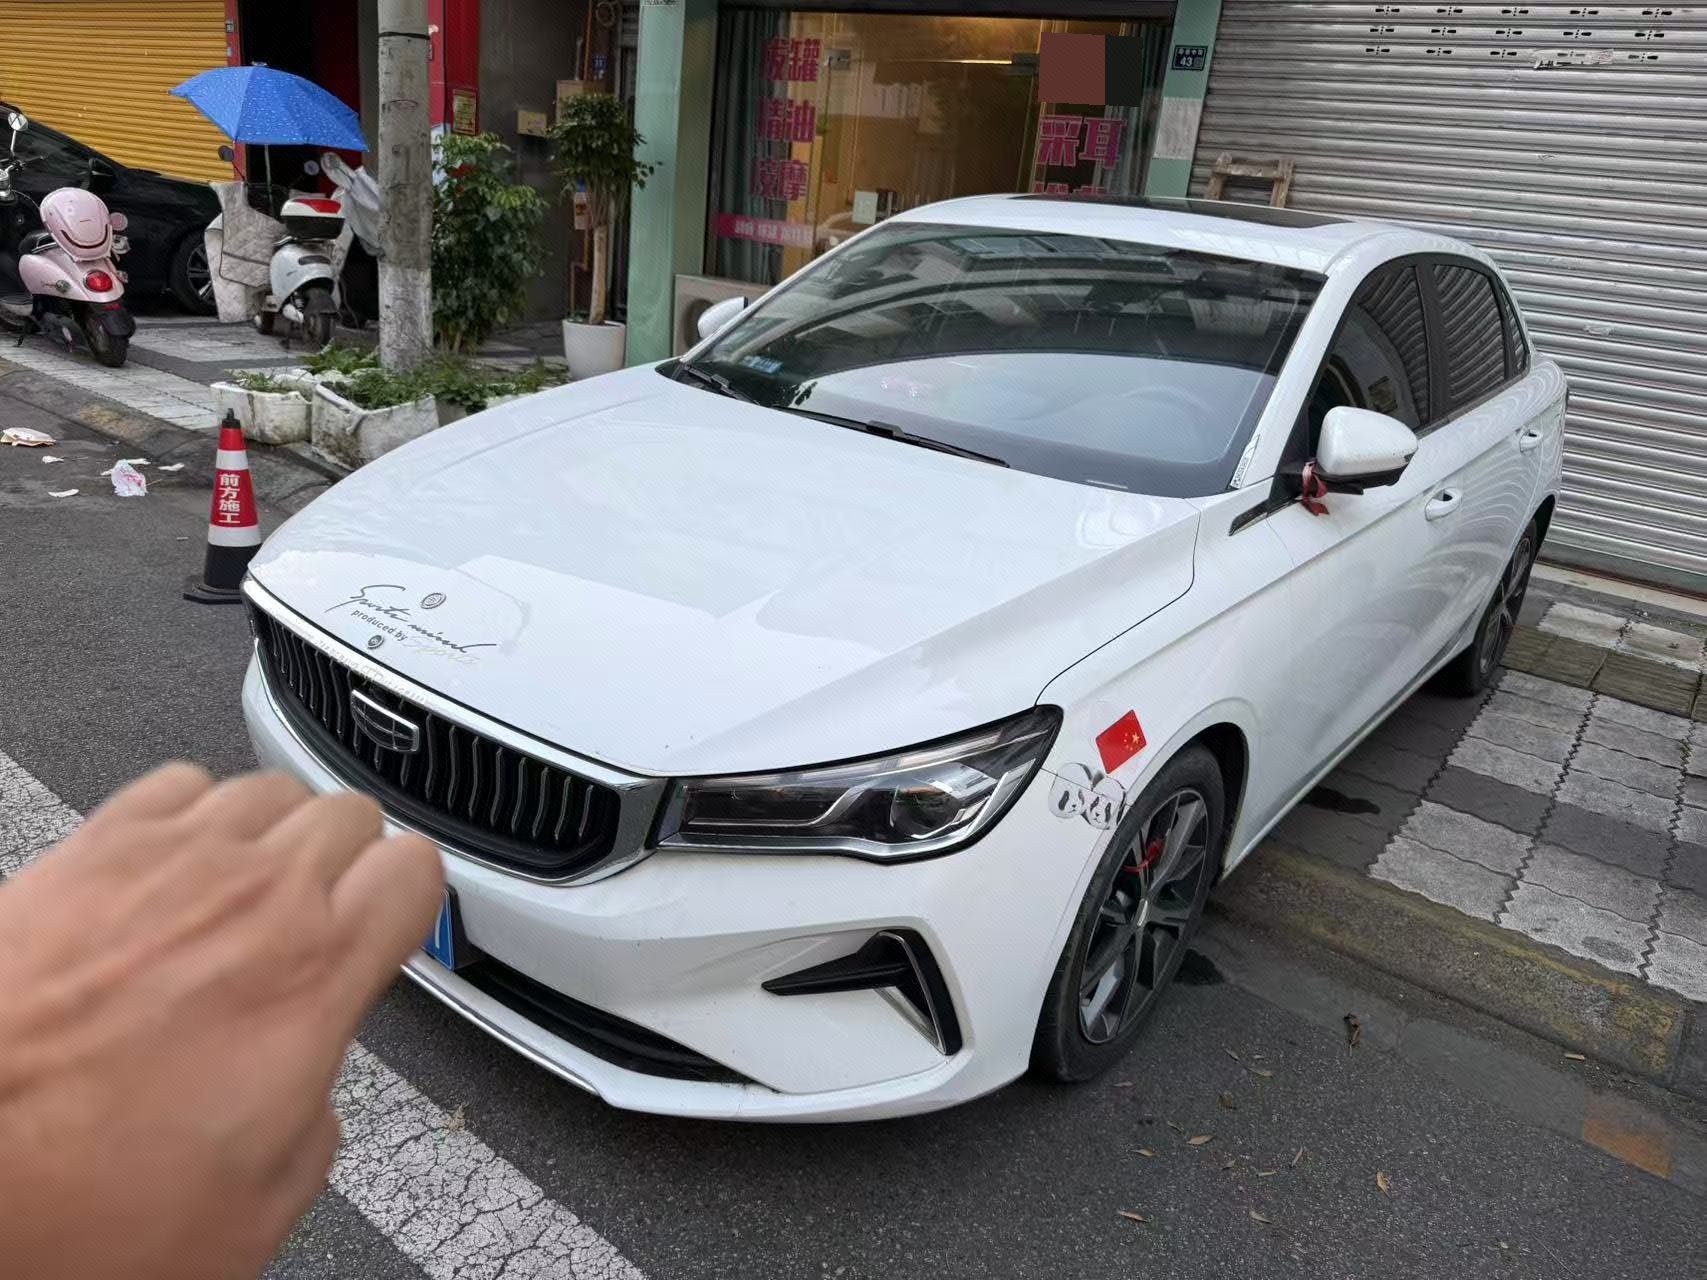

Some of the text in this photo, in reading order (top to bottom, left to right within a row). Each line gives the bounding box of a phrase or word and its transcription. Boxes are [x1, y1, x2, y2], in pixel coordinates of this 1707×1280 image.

[758, 97, 817, 142] 精油
[1034, 115, 1127, 169] 采耳
[752, 159, 808, 201] 按摩
[219, 473, 241, 523] 前方施工
[350, 609, 408, 642] produced by
